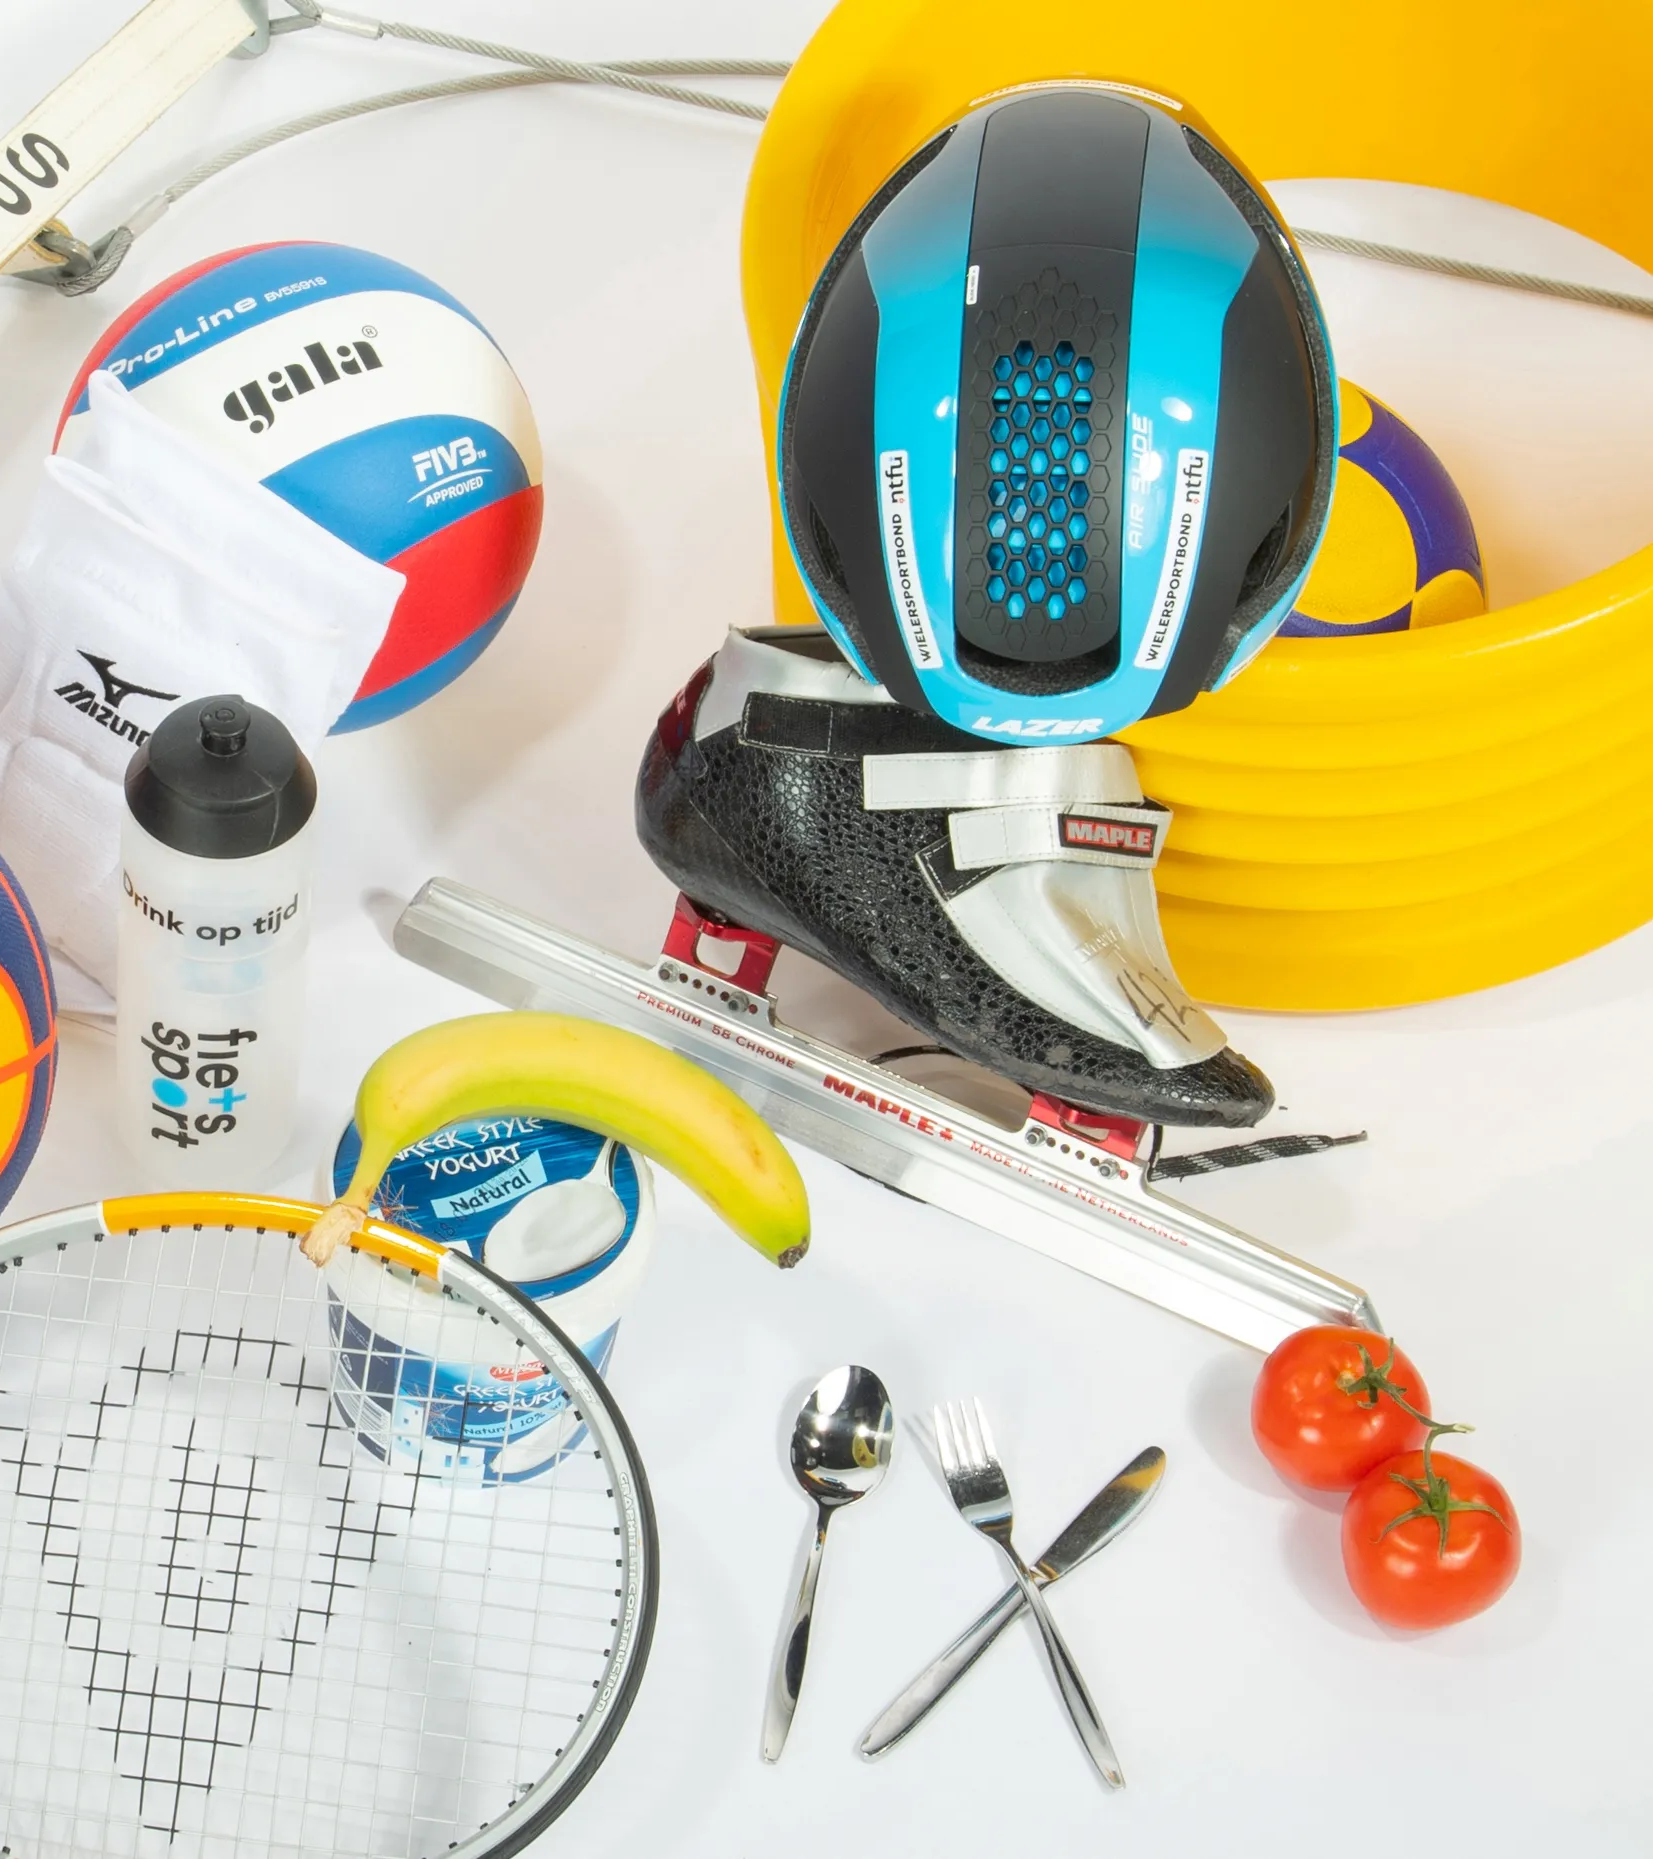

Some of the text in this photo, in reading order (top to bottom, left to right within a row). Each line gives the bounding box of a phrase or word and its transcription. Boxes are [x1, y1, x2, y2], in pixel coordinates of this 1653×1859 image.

[222, 340, 384, 435] gala
[411, 436, 478, 483] FIVB
[425, 475, 485, 508] APPROVED
[891, 512, 932, 663] WIELERSPORTBOND
[1145, 512, 1193, 663] WIELERSPORTBOND
[971, 716, 1105, 738] LAZER
[1065, 820, 1153, 850] MAPLE
[122, 868, 300, 947] Drink op tijd
[636, 990, 702, 1028] PREMIUM
[735, 1035, 796, 1069] CHROME
[822, 1073, 939, 1136] MAPLE
[424, 1141, 522, 1181] YOGURT
[449, 1168, 532, 1213] Natural
[968, 1140, 1014, 1168] MADE
[1074, 1186, 1189, 1247] NETHERLANDS
[618, 1471, 638, 1557] GRAPHITE
